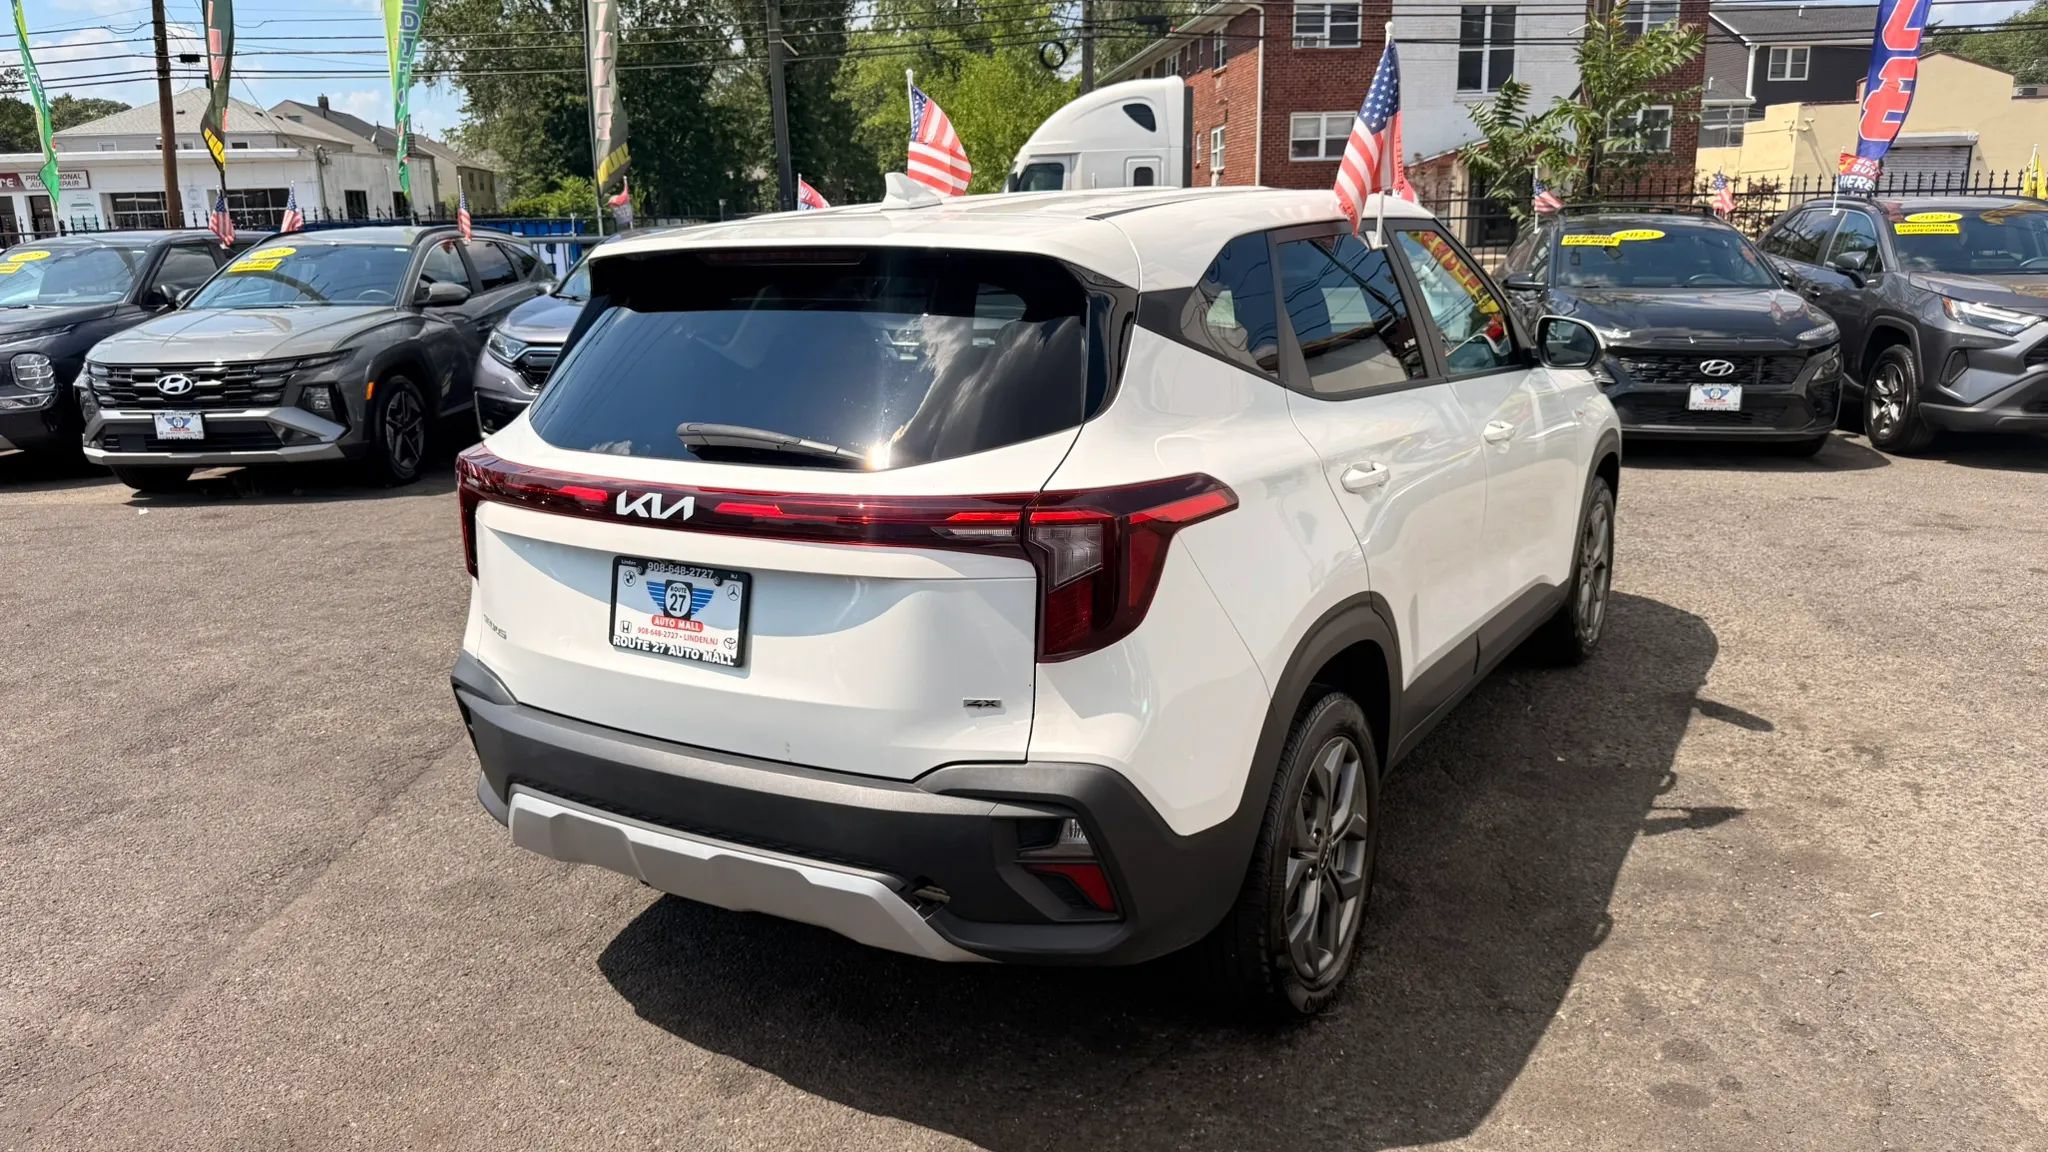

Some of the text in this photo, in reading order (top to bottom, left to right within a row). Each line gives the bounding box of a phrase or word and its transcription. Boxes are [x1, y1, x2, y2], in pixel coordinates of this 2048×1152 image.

[1840, 175, 1876, 191] HERE
[616, 490, 695, 521] KIA
[647, 562, 714, 579] 908-648-2727
[670, 586, 688, 594] ROUTE
[669, 592, 687, 612] 27
[654, 617, 701, 631] AUTO MALL
[637, 627, 679, 640] 908-648-2727
[613, 635, 735, 666] ROUTE 27 AUTO MALL
